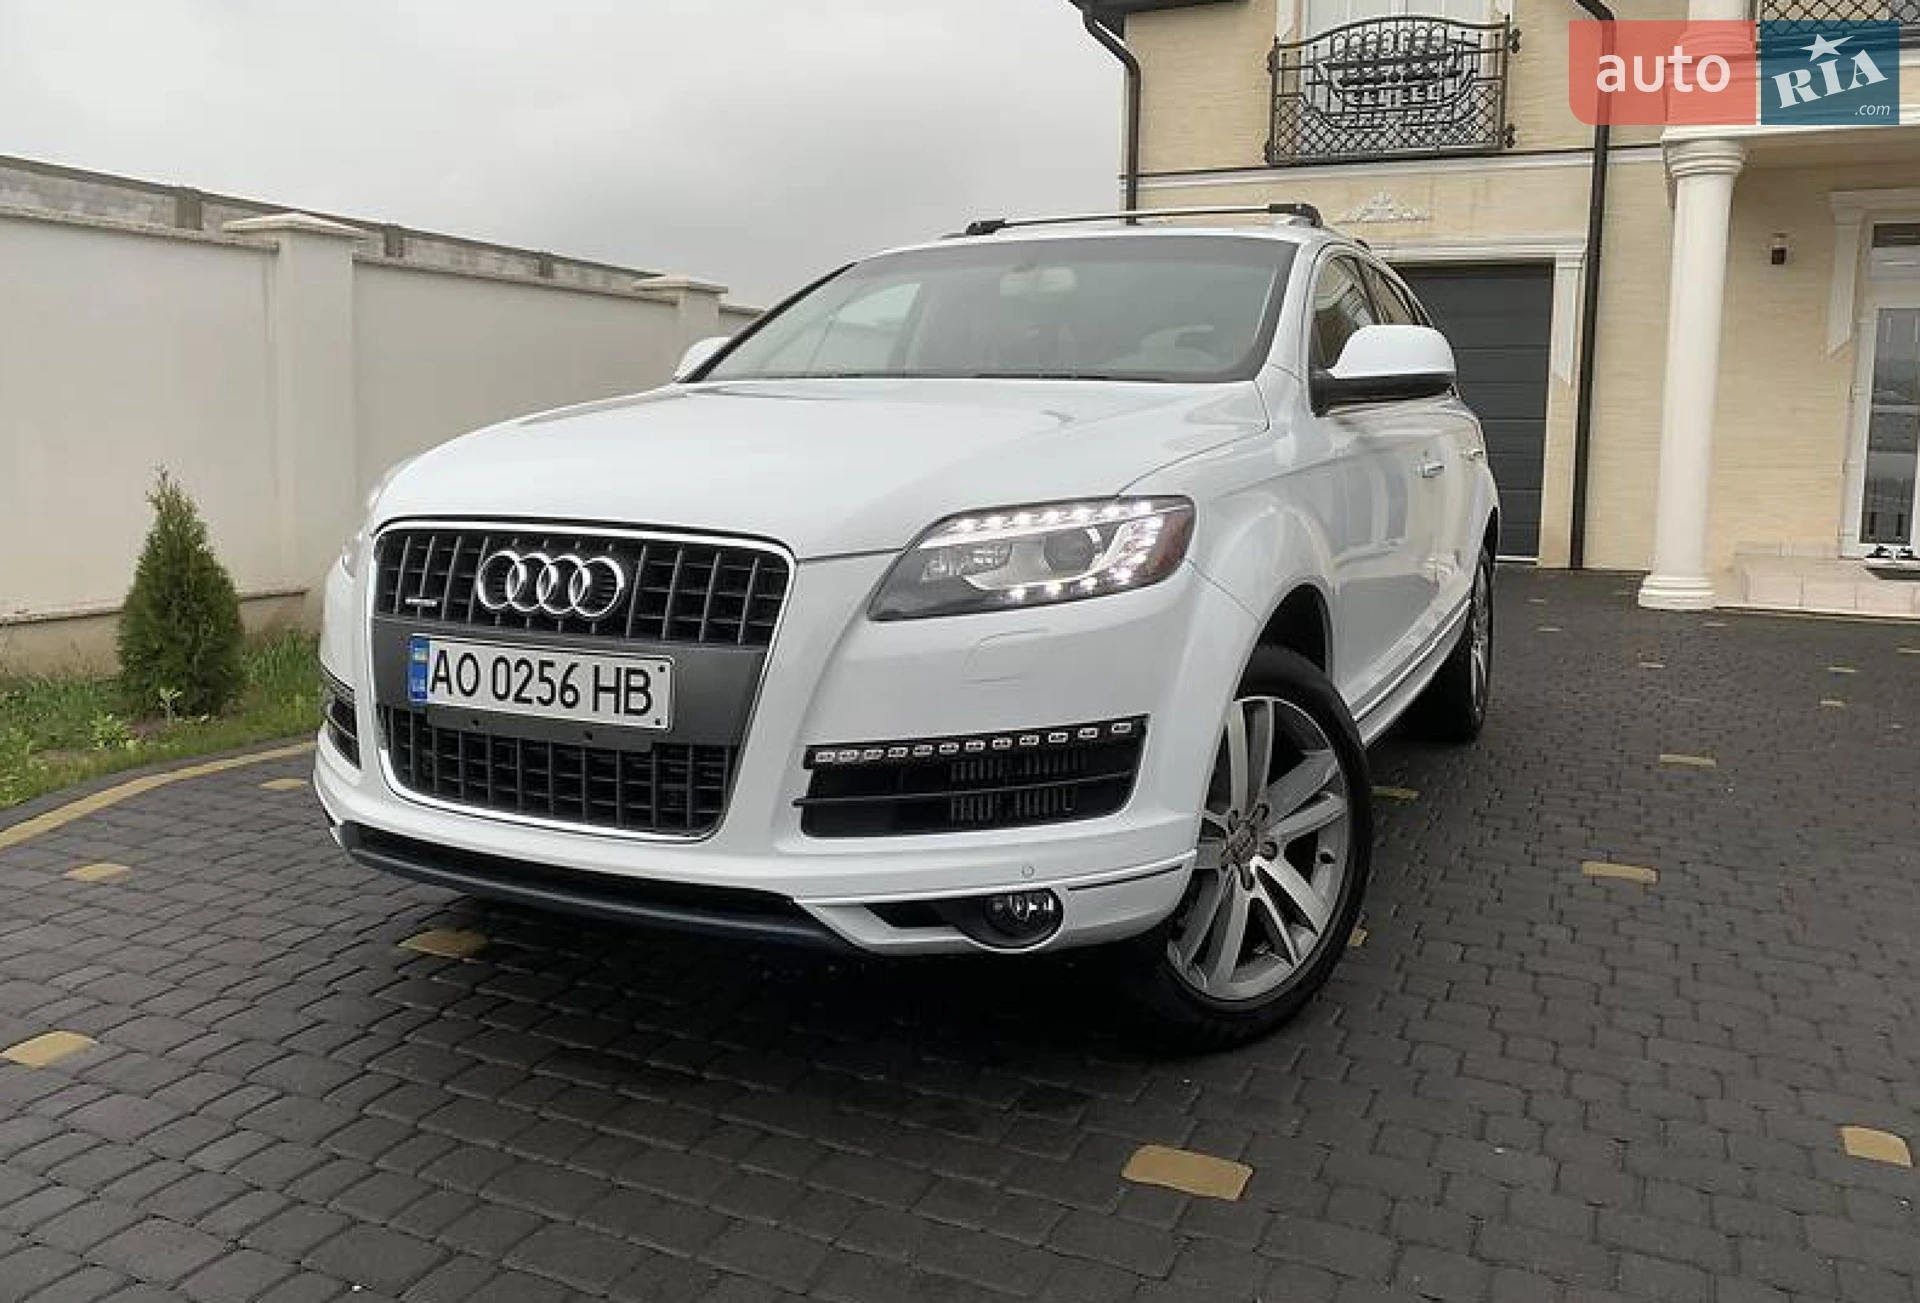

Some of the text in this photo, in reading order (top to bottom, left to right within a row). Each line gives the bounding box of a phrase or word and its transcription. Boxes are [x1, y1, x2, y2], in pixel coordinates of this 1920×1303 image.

[430, 649, 651, 716] AO 0256 HB
